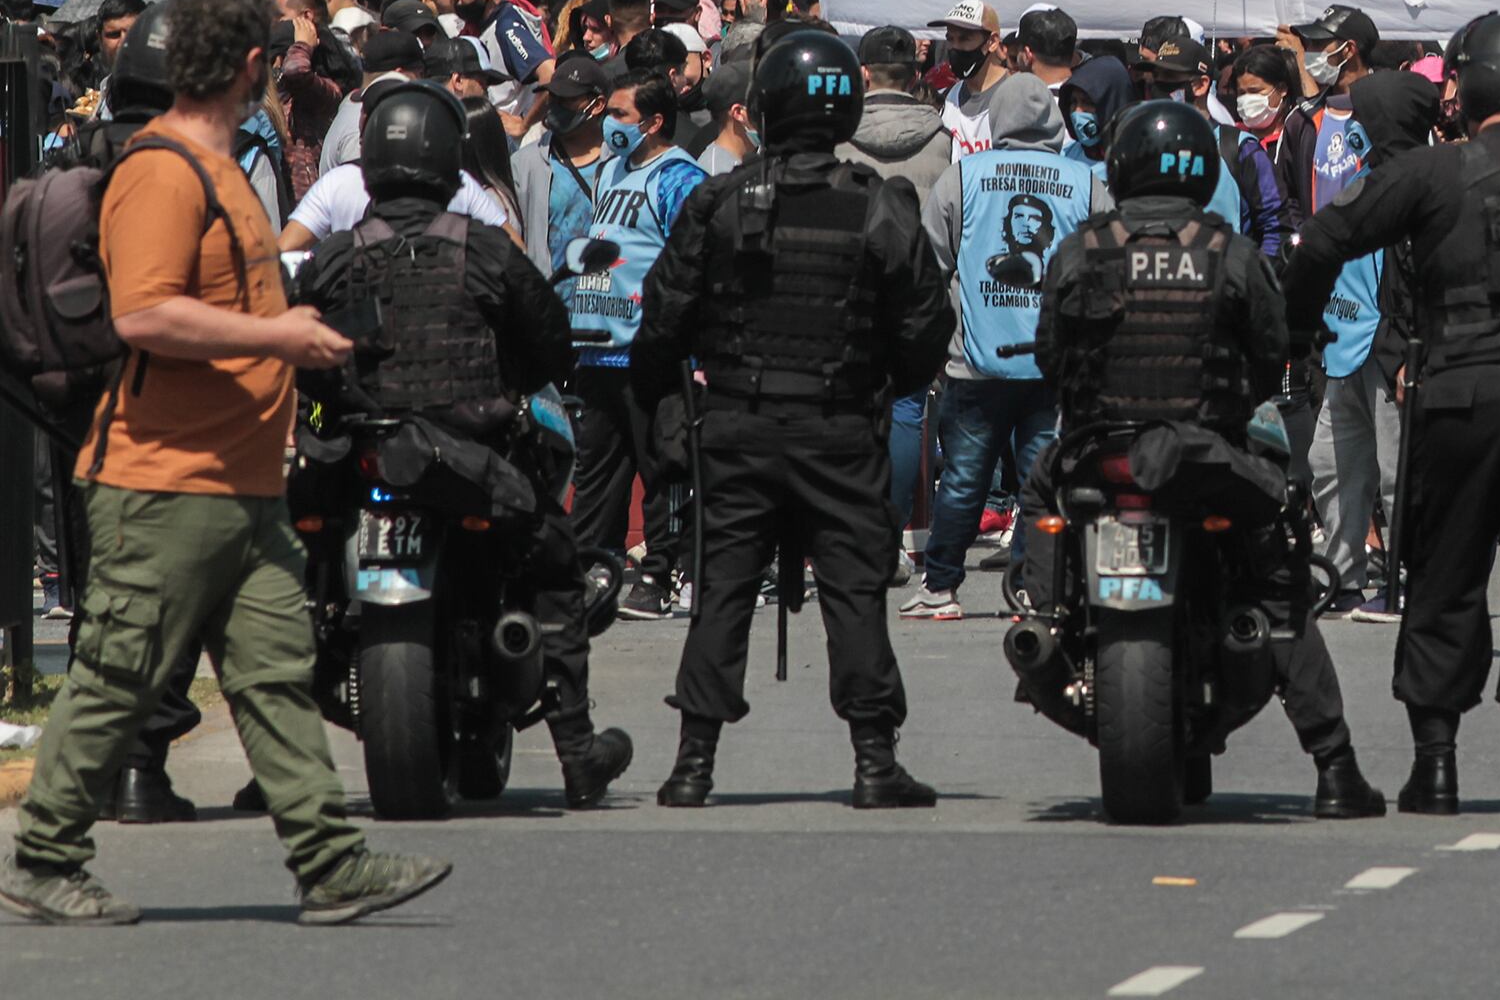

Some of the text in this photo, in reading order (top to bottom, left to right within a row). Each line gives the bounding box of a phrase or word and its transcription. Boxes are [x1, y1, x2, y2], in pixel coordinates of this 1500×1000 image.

[808, 74, 851, 95] PFA
[996, 163, 1060, 181] MOVIMIENTO
[1160, 152, 1204, 176] PFA
[981, 178, 1074, 199] TERESA RODRIGUEZ
[593, 188, 647, 229] MTR
[1131, 252, 1204, 281] P.F.A.
[983, 294, 990, 307] Y
[992, 294, 1030, 309] CAMBIO
[378, 535, 422, 555] ETM
[1099, 577, 1163, 600] PFA
